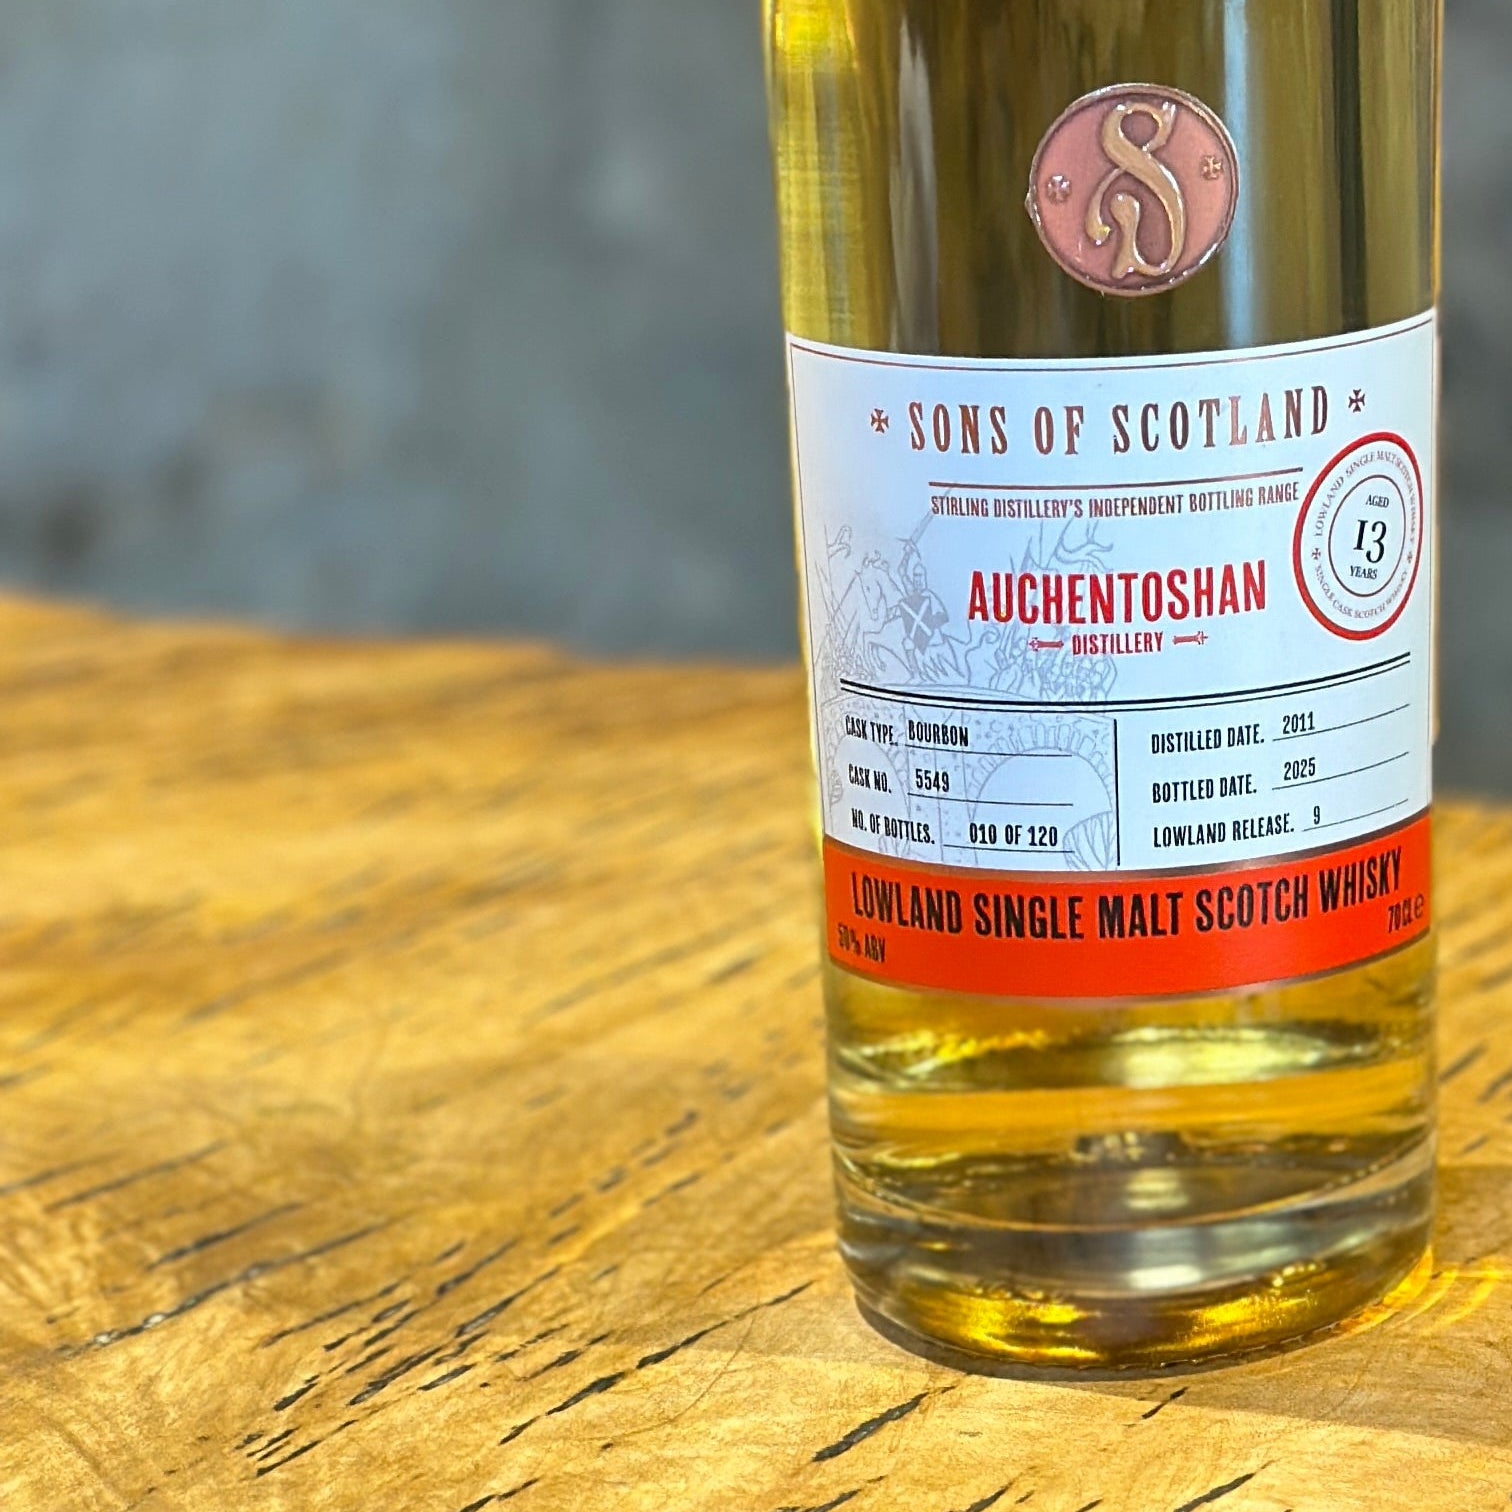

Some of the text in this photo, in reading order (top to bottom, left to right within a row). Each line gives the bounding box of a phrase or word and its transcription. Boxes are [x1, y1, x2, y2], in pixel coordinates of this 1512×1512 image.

[908, 385, 1328, 455] SONS OF SCOTLAND
[931, 482, 1299, 519] STIRLING DISTILLERY'S INDEPENDENT BOTTLING RANGE
[1314, 476, 1345, 537] LOWLAND
[1365, 494, 1390, 509] AGED
[1353, 519, 1387, 564] 13
[968, 559, 1266, 624] AUCHENTOSHAN
[1349, 565, 1378, 580] YEARS
[1072, 631, 1163, 656] DISTILLERY
[845, 714, 969, 747] CASK TYPE. BOURBON
[1151, 711, 1315, 754] DISTILLED DATE. 2011
[848, 763, 950, 793] CASK NO. 5549
[1152, 757, 1316, 803] BOTTLED DATE. 2025
[851, 808, 1058, 847] NO. OF BOTTLES. 010 OF 120
[1153, 805, 1321, 848] LOWLAND RELEASE. 9
[852, 846, 1402, 940] LOWLAND SINGLE MALT SCOTCH WHISKY
[865, 933, 886, 963] ABV
